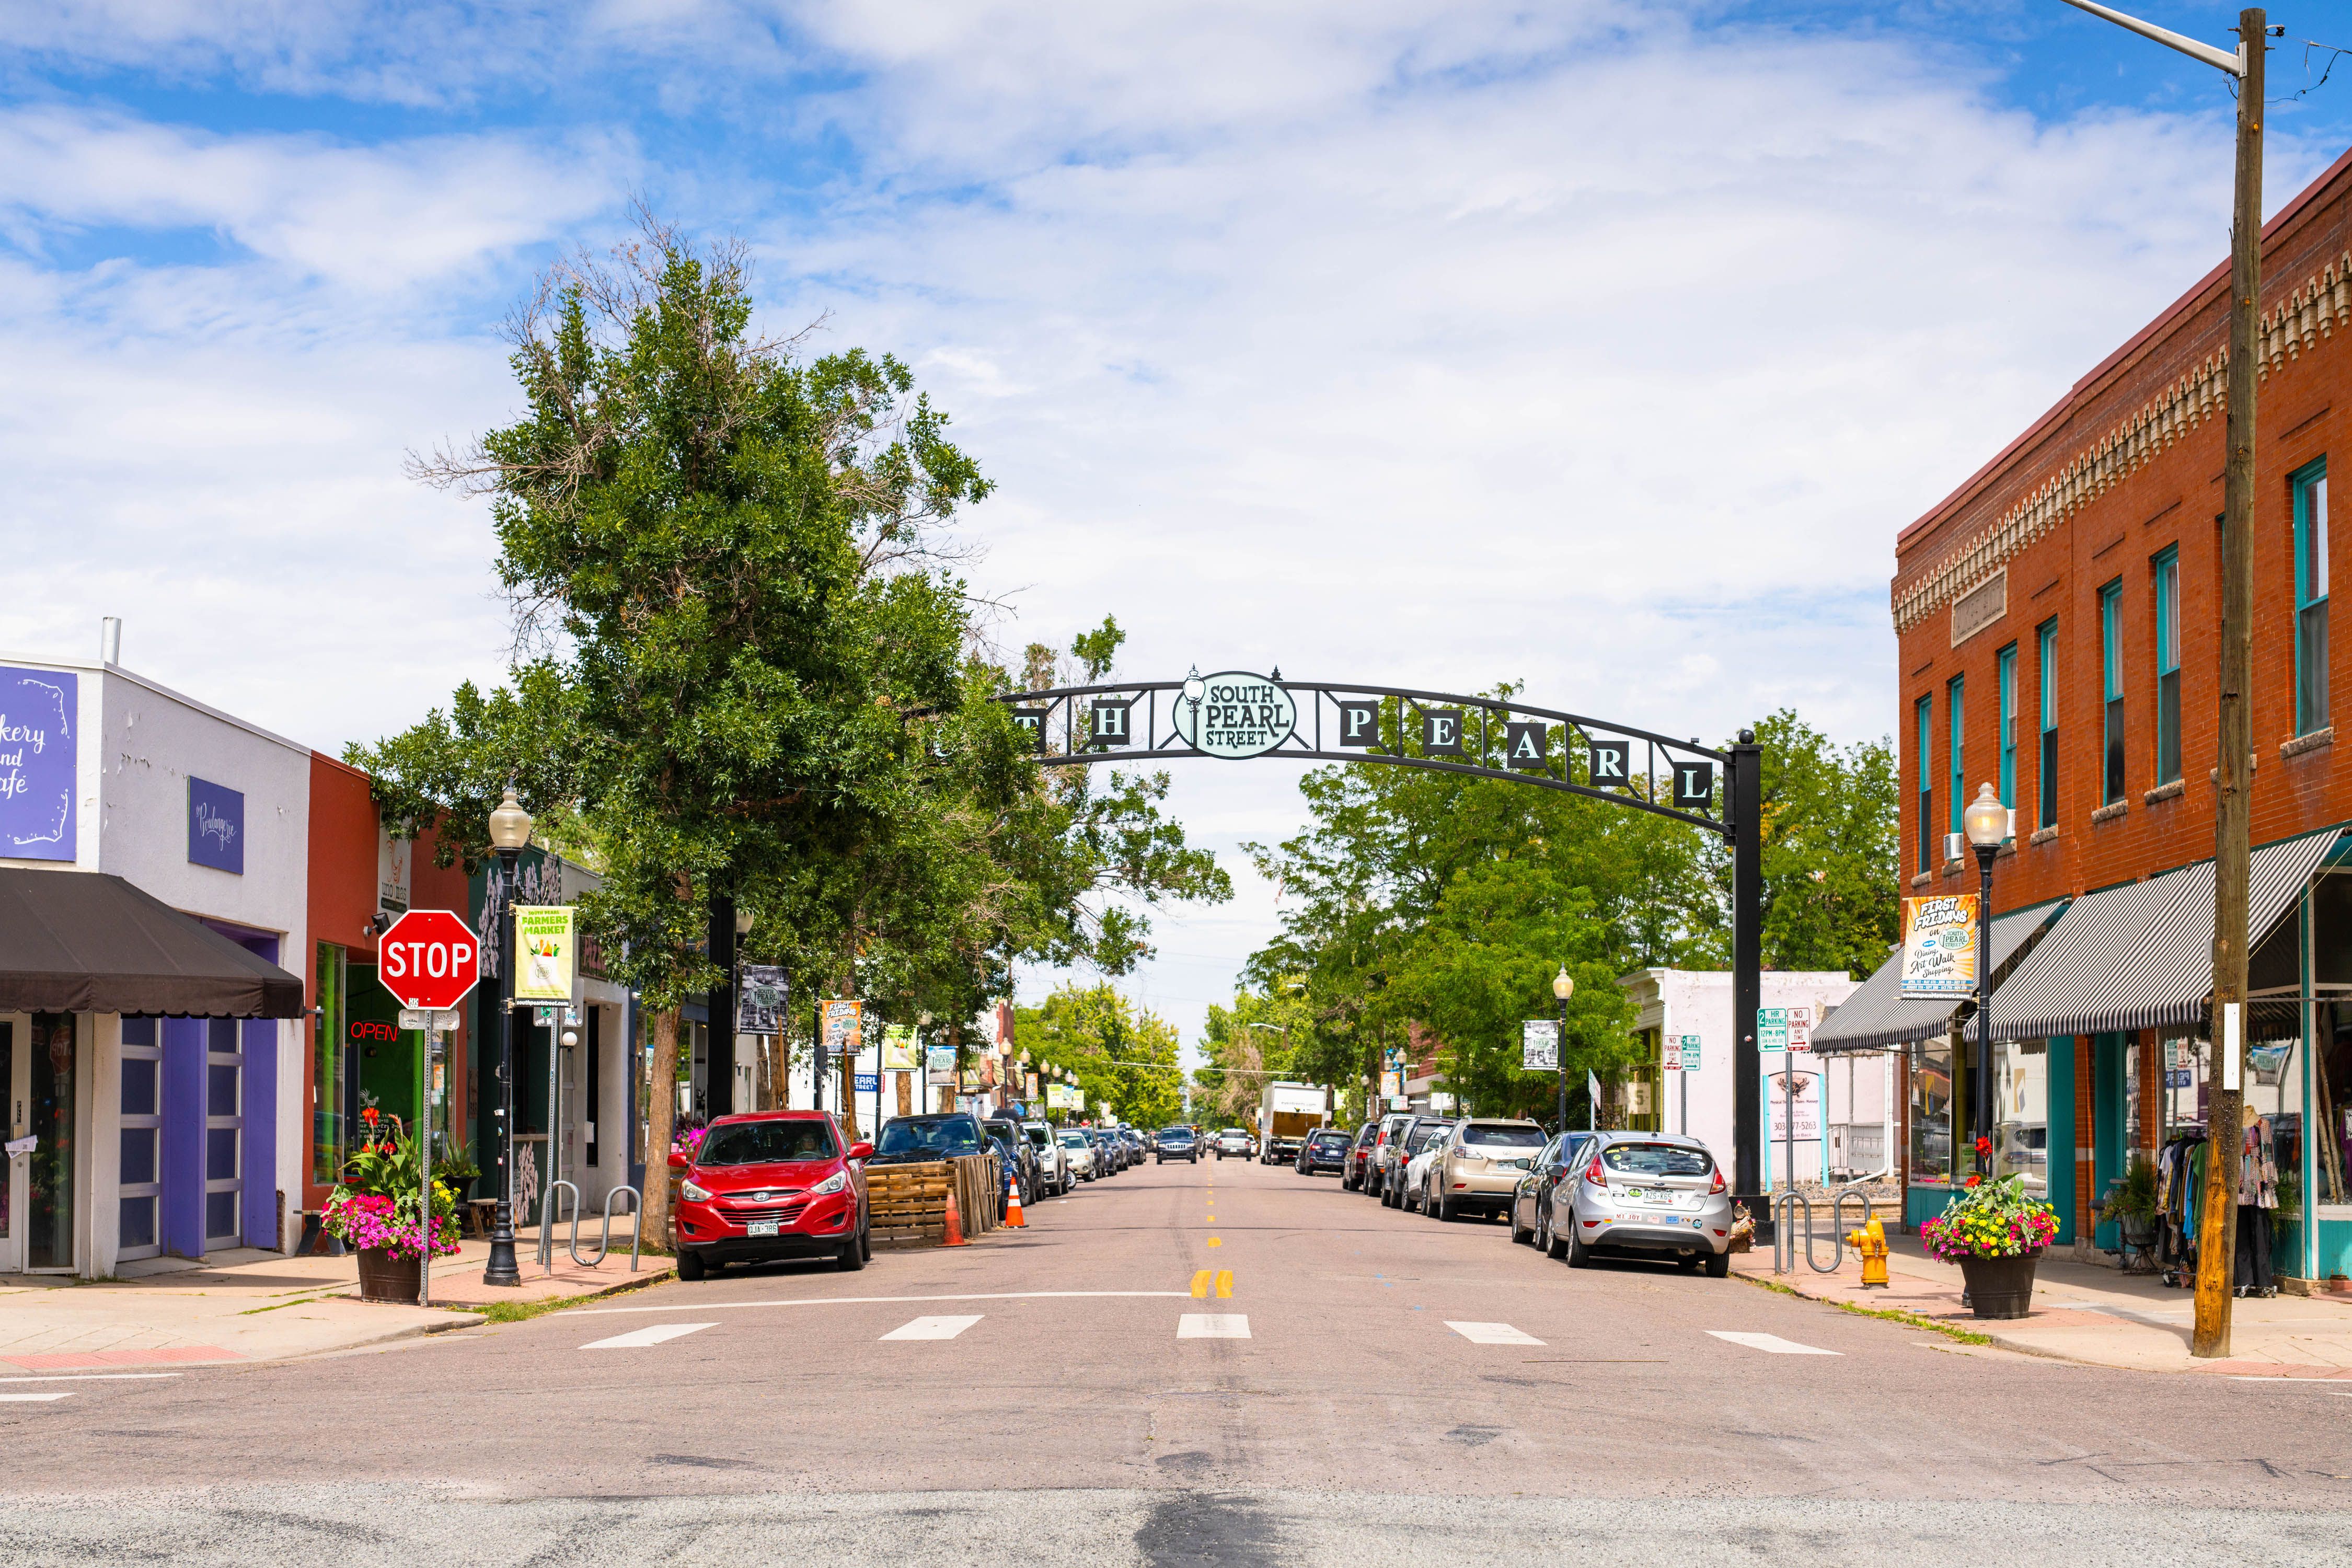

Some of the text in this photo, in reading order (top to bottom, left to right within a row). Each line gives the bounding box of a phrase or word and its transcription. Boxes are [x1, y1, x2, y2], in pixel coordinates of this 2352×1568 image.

[1210, 685, 1274, 703] SOUTH
[1206, 704, 1289, 737] PEARL
[1206, 730, 1267, 749] STREET
[0, 748, 23, 767] nd
[200, 802, 237, 851] Boulangerie
[382, 882, 407, 901] uno mas
[1920, 897, 1957, 916] FIRST
[522, 916, 569, 925] FARMERS
[1913, 910, 1968, 931] FRIDAYS
[524, 925, 566, 935] MARKET
[1945, 936, 1967, 944] PEARL
[387, 942, 471, 978] STOP
[1915, 949, 1938, 959] Dining
[1910, 953, 1955, 974] Art Walk
[1922, 966, 1954, 978] Shopping
[757, 994, 777, 1002] PEARL
[829, 1001, 850, 1011] FIRST
[826, 1008, 857, 1019] FRIDAYS
[1759, 1012, 1765, 1024] 2
[1789, 1020, 1809, 1029] PARKING
[351, 1022, 398, 1041] OPEN
[826, 1034, 835, 1043] Art
[1683, 1038, 1687, 1048] 2
